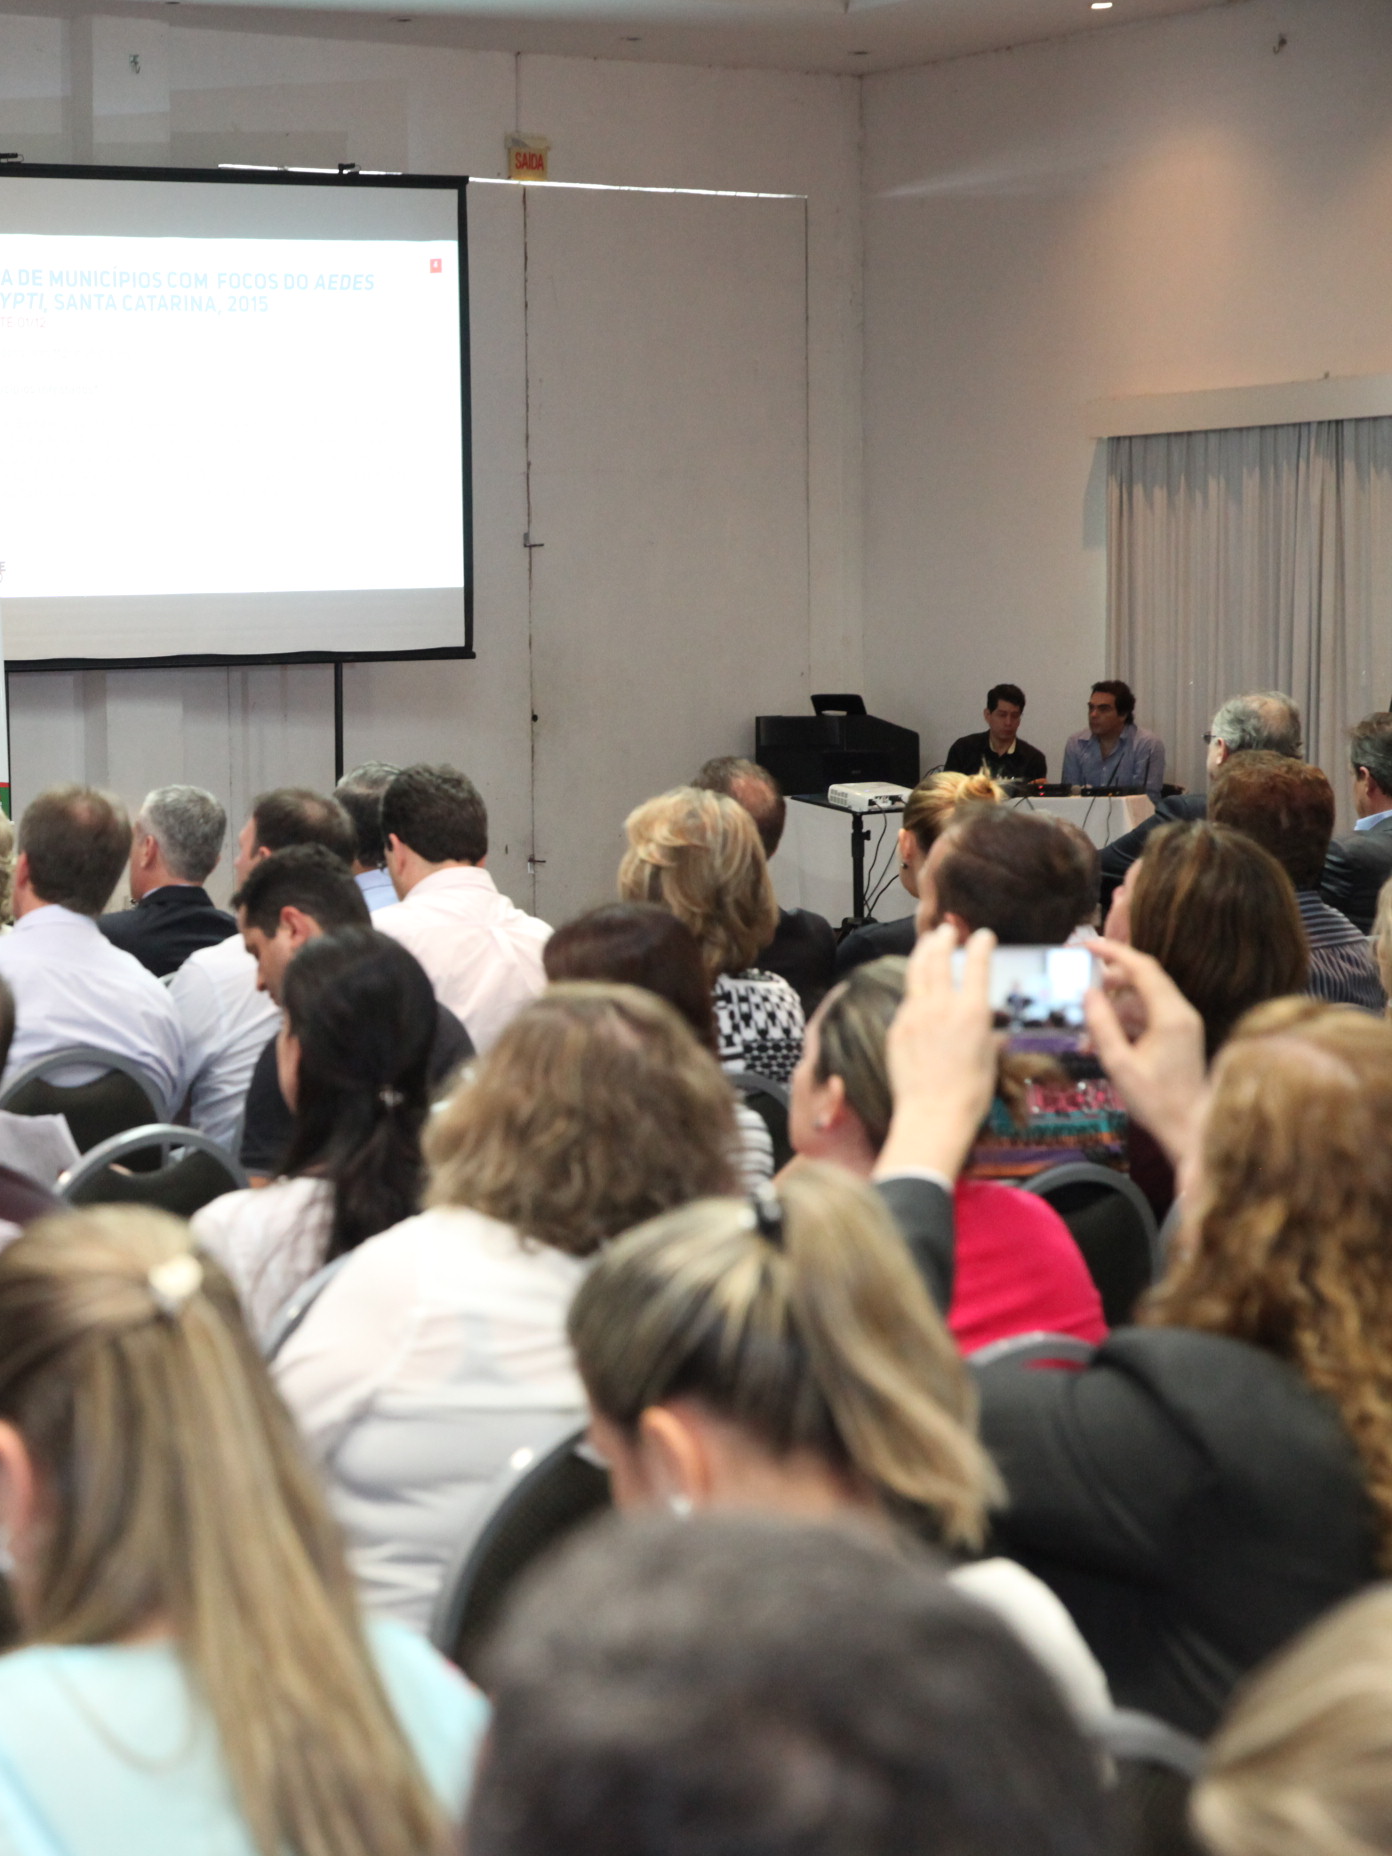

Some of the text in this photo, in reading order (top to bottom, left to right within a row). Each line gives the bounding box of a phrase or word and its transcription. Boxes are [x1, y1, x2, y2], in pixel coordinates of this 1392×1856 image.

[17, 268, 44, 287] DE
[49, 265, 163, 289] MUNICÍPIOS
[166, 271, 209, 290] COM
[217, 272, 279, 290] FOCOS
[283, 273, 309, 291] DO
[313, 273, 376, 292] AEDES
[54, 293, 118, 312] SANTA
[122, 293, 222, 316] CATARINA,
[227, 295, 269, 313] 2015
